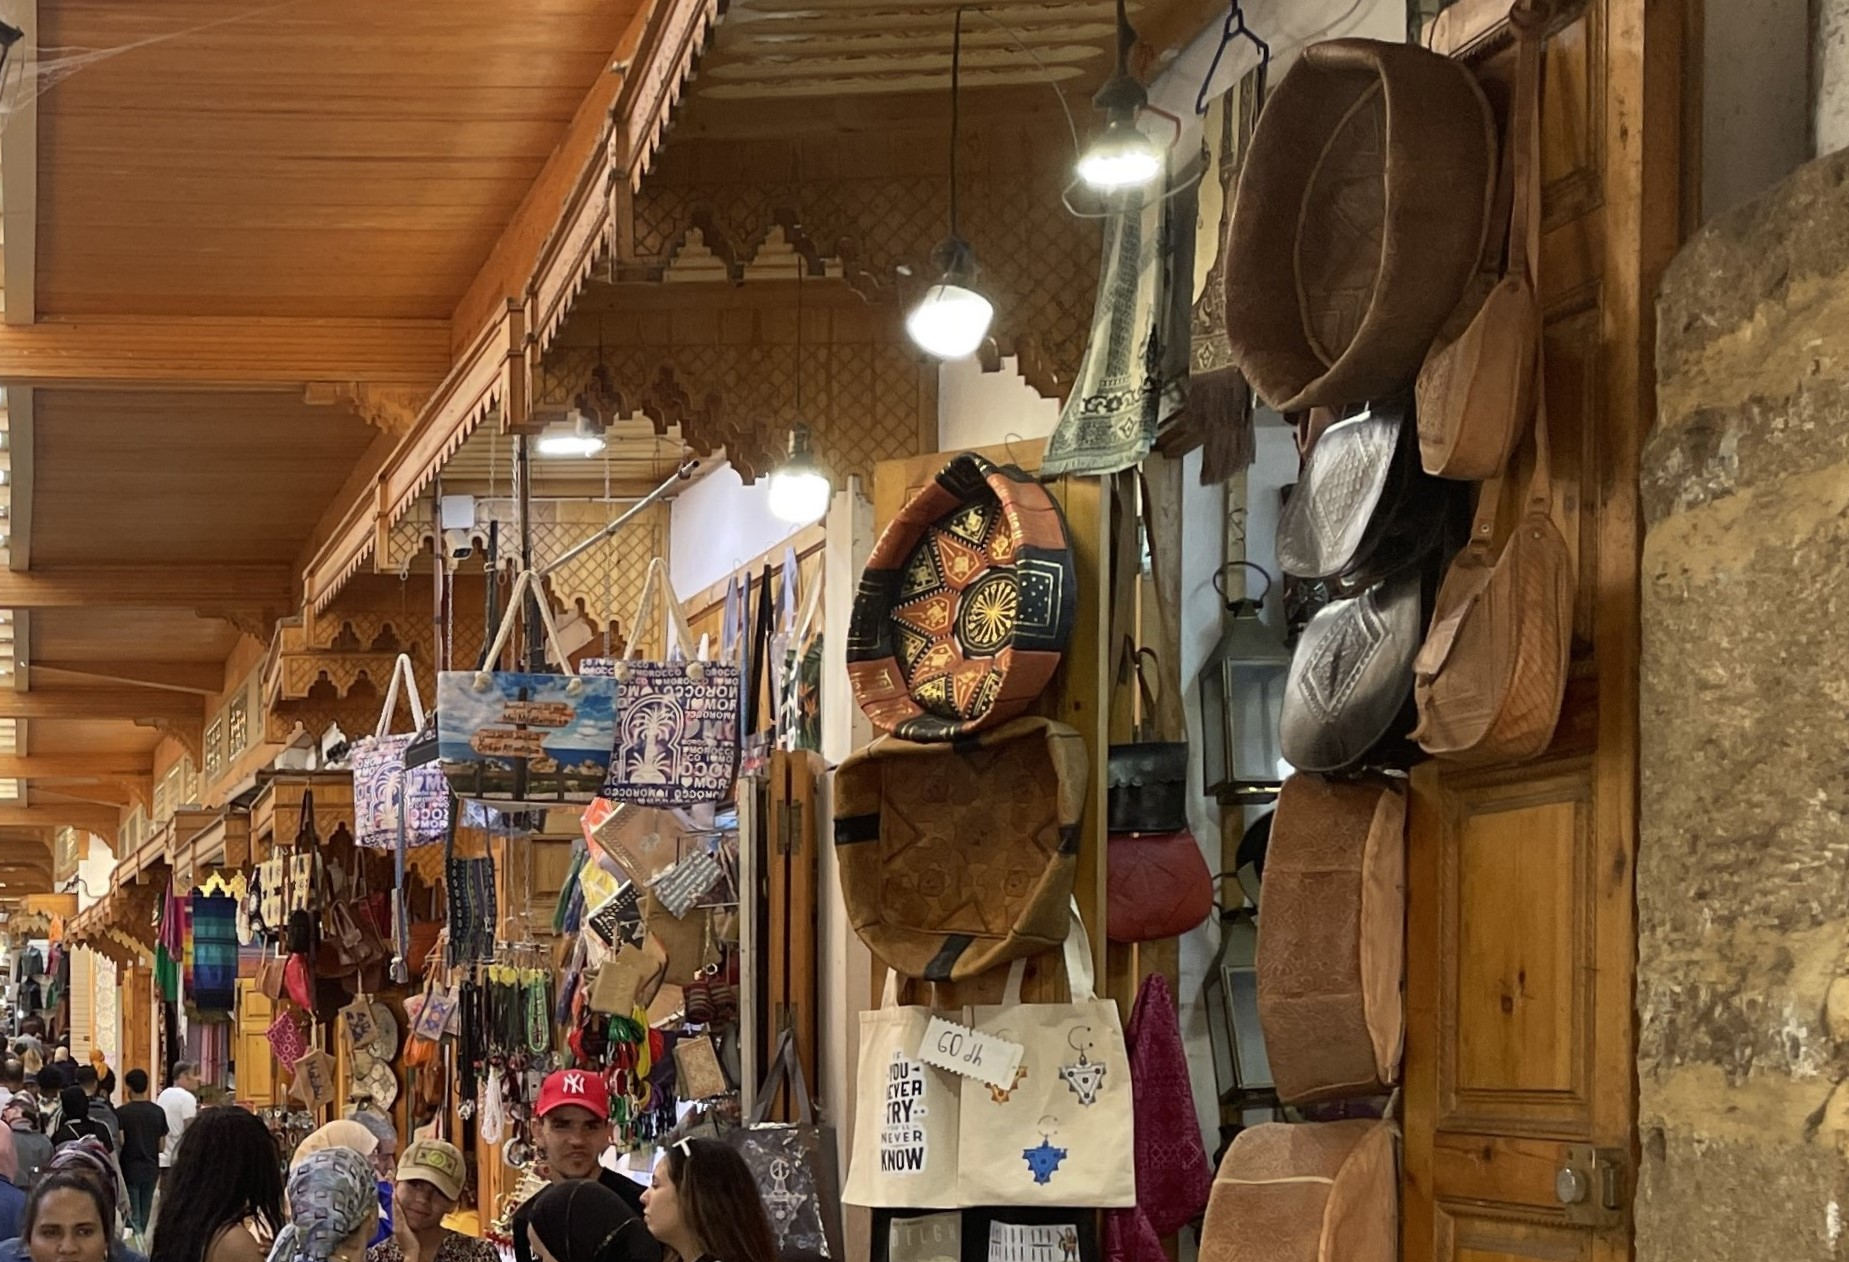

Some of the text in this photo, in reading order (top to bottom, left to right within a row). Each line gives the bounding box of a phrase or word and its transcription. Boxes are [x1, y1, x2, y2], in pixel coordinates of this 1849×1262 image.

[964, 1043, 982, 1067] dh
[887, 1079, 923, 1100] EVER
[881, 1130, 923, 1144] NEVER
[881, 1147, 924, 1172] KNOW
